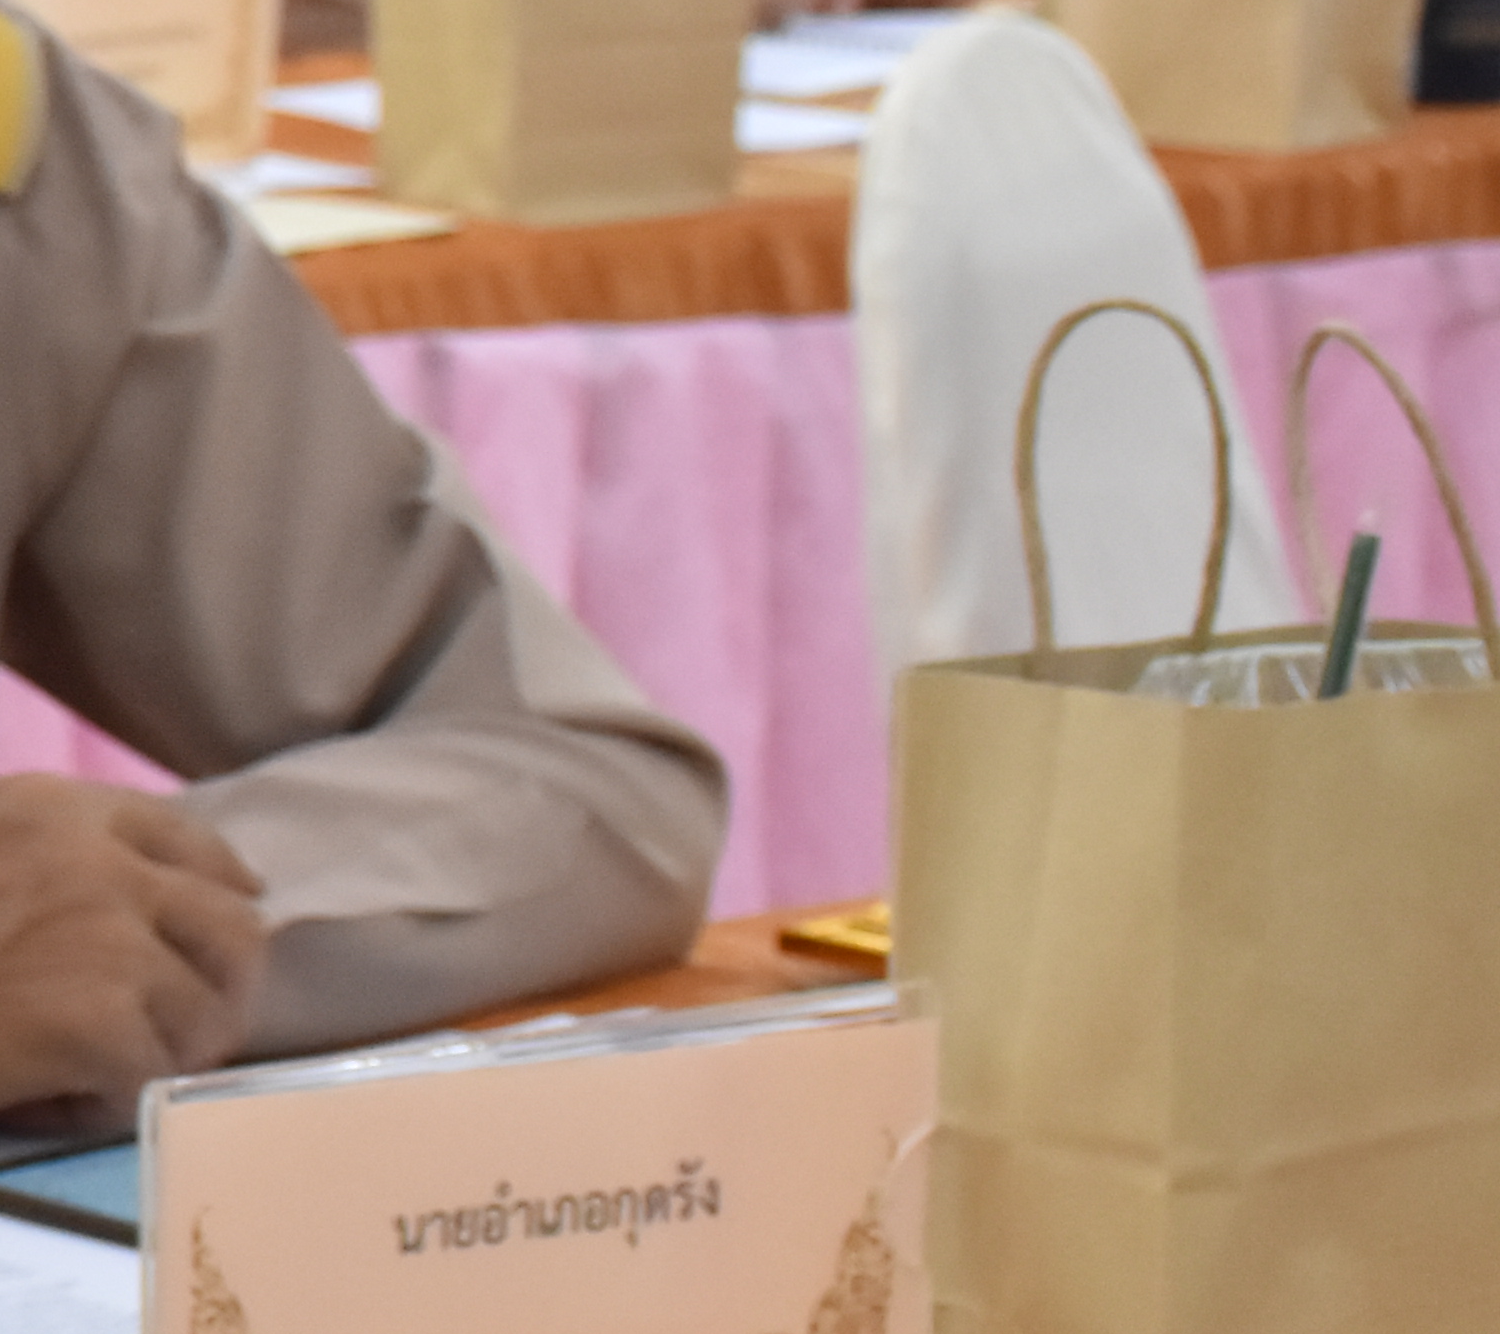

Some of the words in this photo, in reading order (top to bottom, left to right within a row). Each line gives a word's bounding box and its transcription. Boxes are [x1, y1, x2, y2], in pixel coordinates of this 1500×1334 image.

[394, 1157, 722, 1255] นายอำเภอกุดรัง
